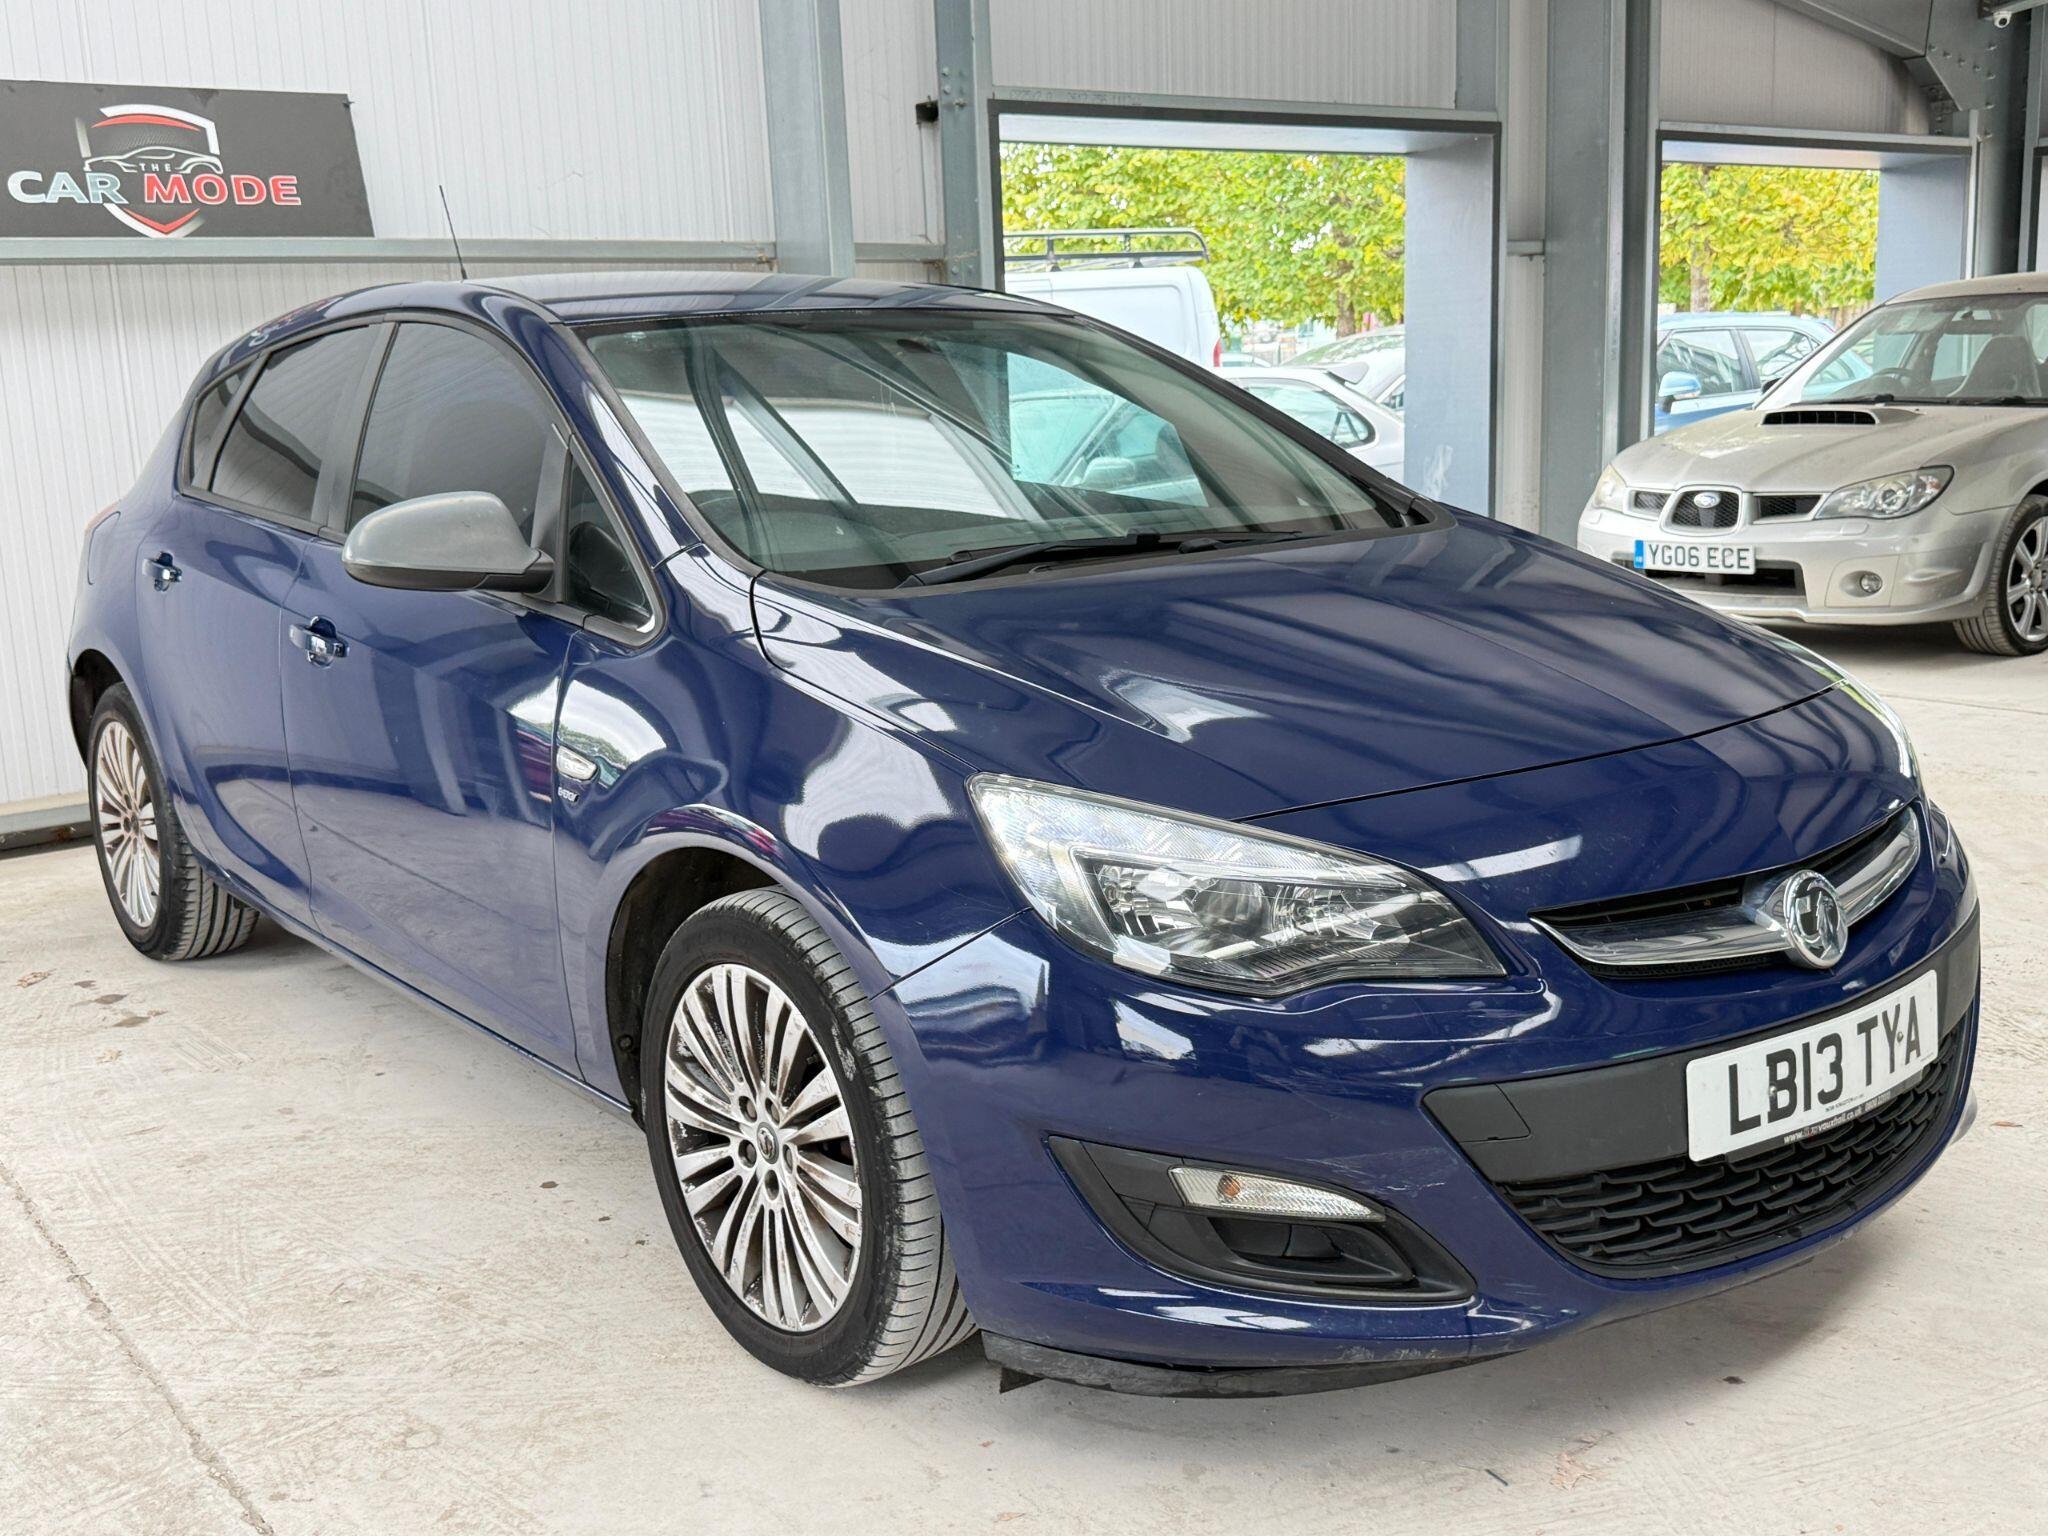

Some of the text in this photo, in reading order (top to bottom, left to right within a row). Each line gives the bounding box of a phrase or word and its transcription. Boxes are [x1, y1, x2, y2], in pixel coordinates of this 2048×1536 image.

[138, 162, 172, 173] THE
[7, 170, 302, 206] CAR MODE
[1648, 543, 1750, 569] YG06 ECE
[1728, 996, 1921, 1136] LB13 TYA
